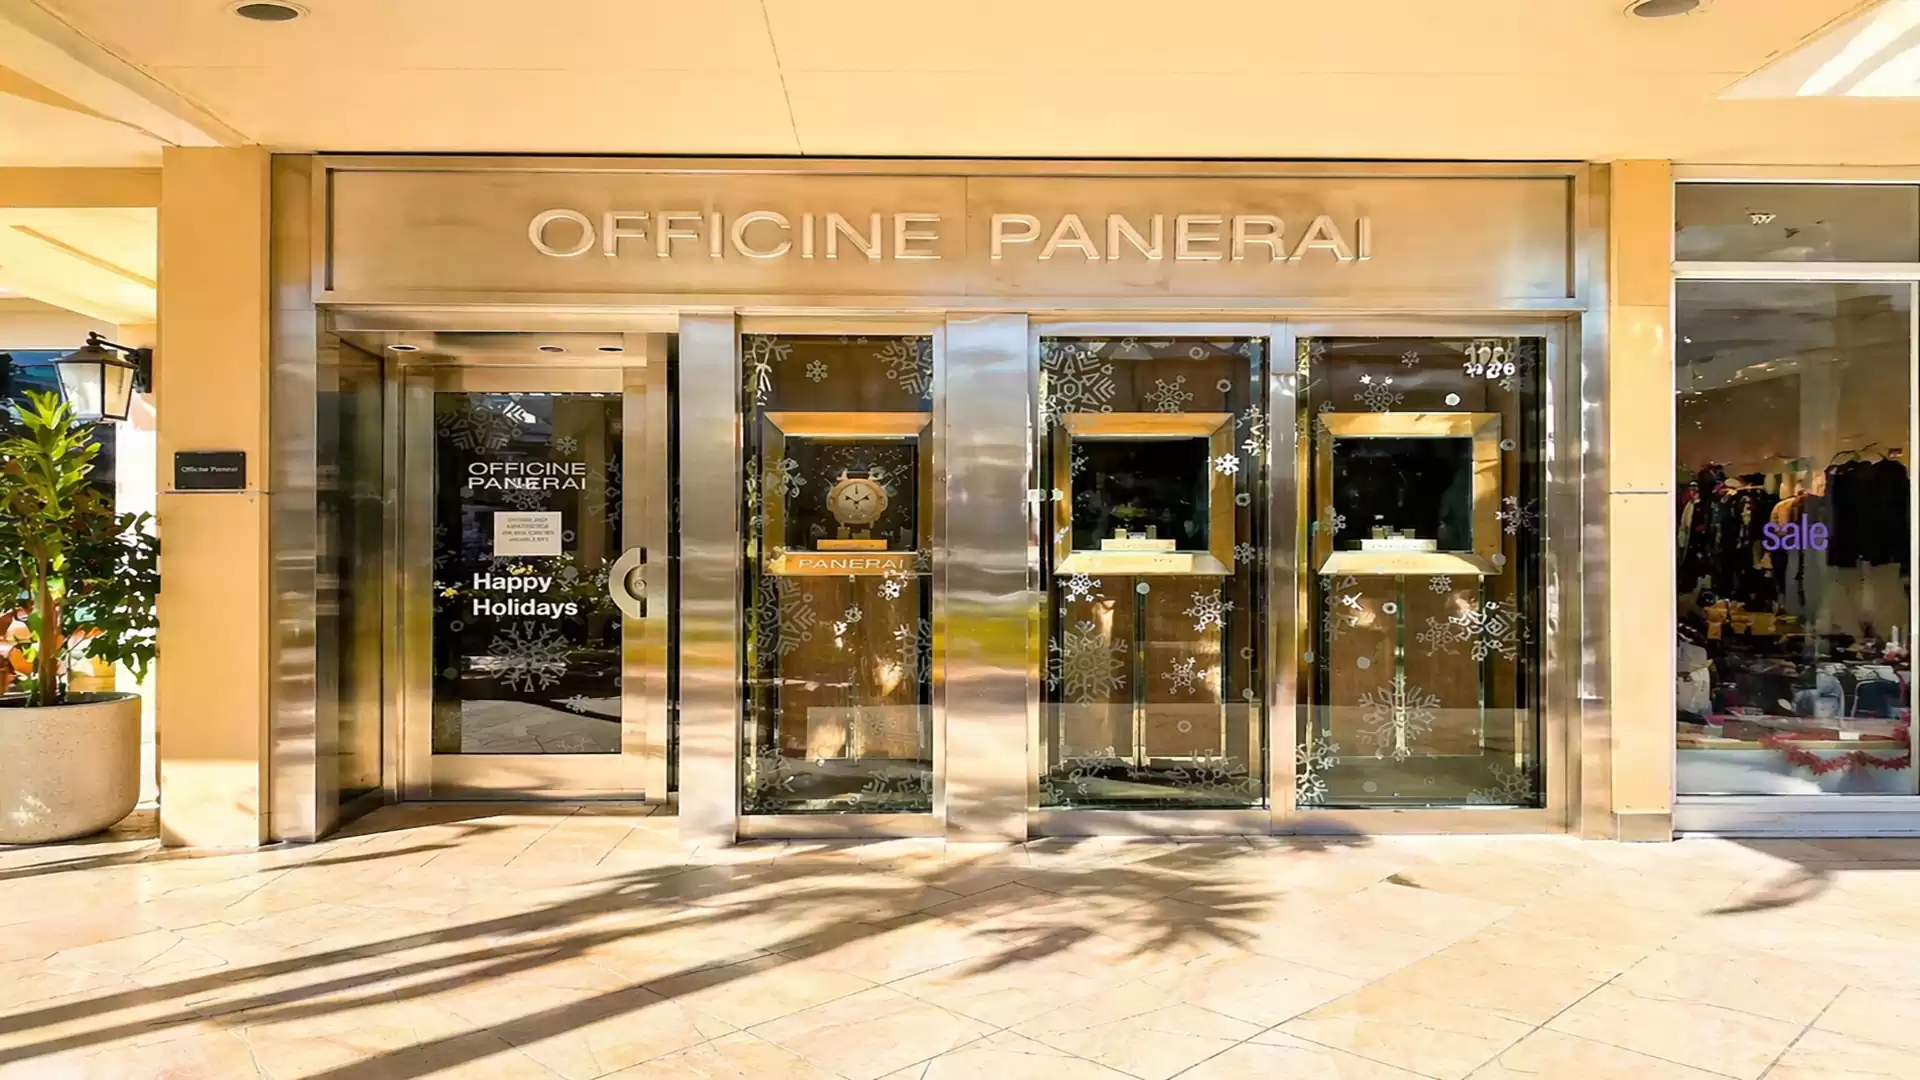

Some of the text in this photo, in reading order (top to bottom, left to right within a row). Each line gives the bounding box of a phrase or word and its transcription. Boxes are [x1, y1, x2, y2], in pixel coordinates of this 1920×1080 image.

[528, 208, 1372, 260] OFFICINE PANERAI
[468, 462, 586, 476] OFFICINE
[468, 477, 586, 490] PANERAI
[1762, 513, 1829, 551] sale
[798, 559, 904, 569] PANERAI
[473, 573, 552, 593] Happy
[473, 598, 578, 619] Holidays
